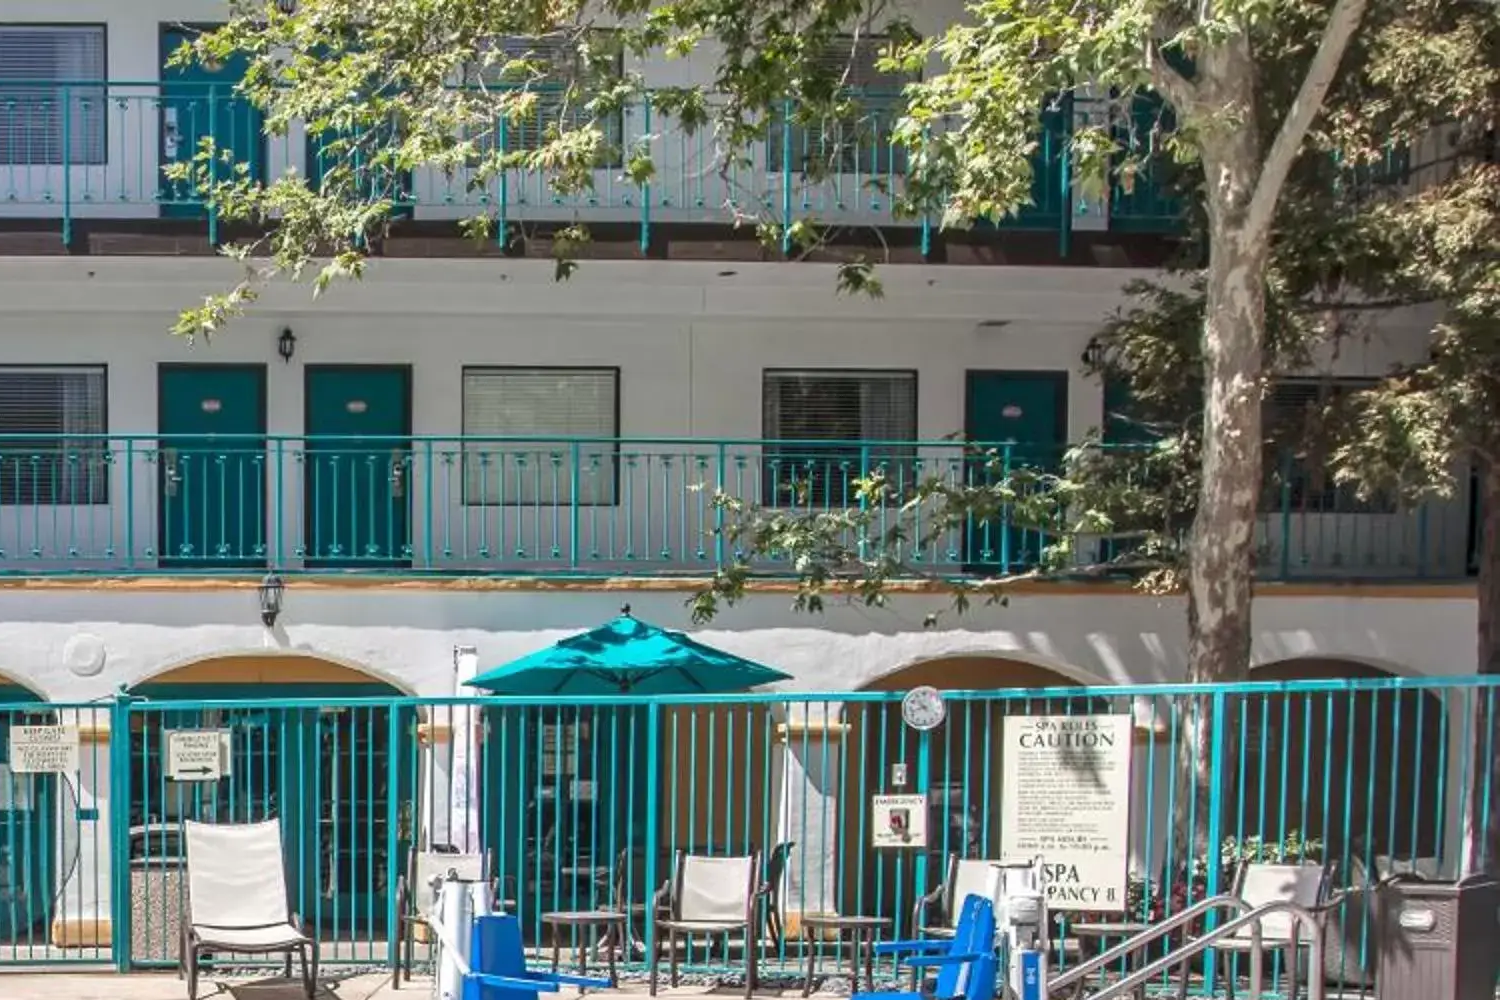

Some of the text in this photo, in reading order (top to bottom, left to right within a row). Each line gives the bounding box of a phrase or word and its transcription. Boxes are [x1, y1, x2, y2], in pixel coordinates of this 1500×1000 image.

[1035, 721, 1057, 731] SPA
[1019, 732, 1116, 748] CAUTION
[1043, 864, 1080, 882] SPA
[1047, 886, 1100, 902] PANCY
